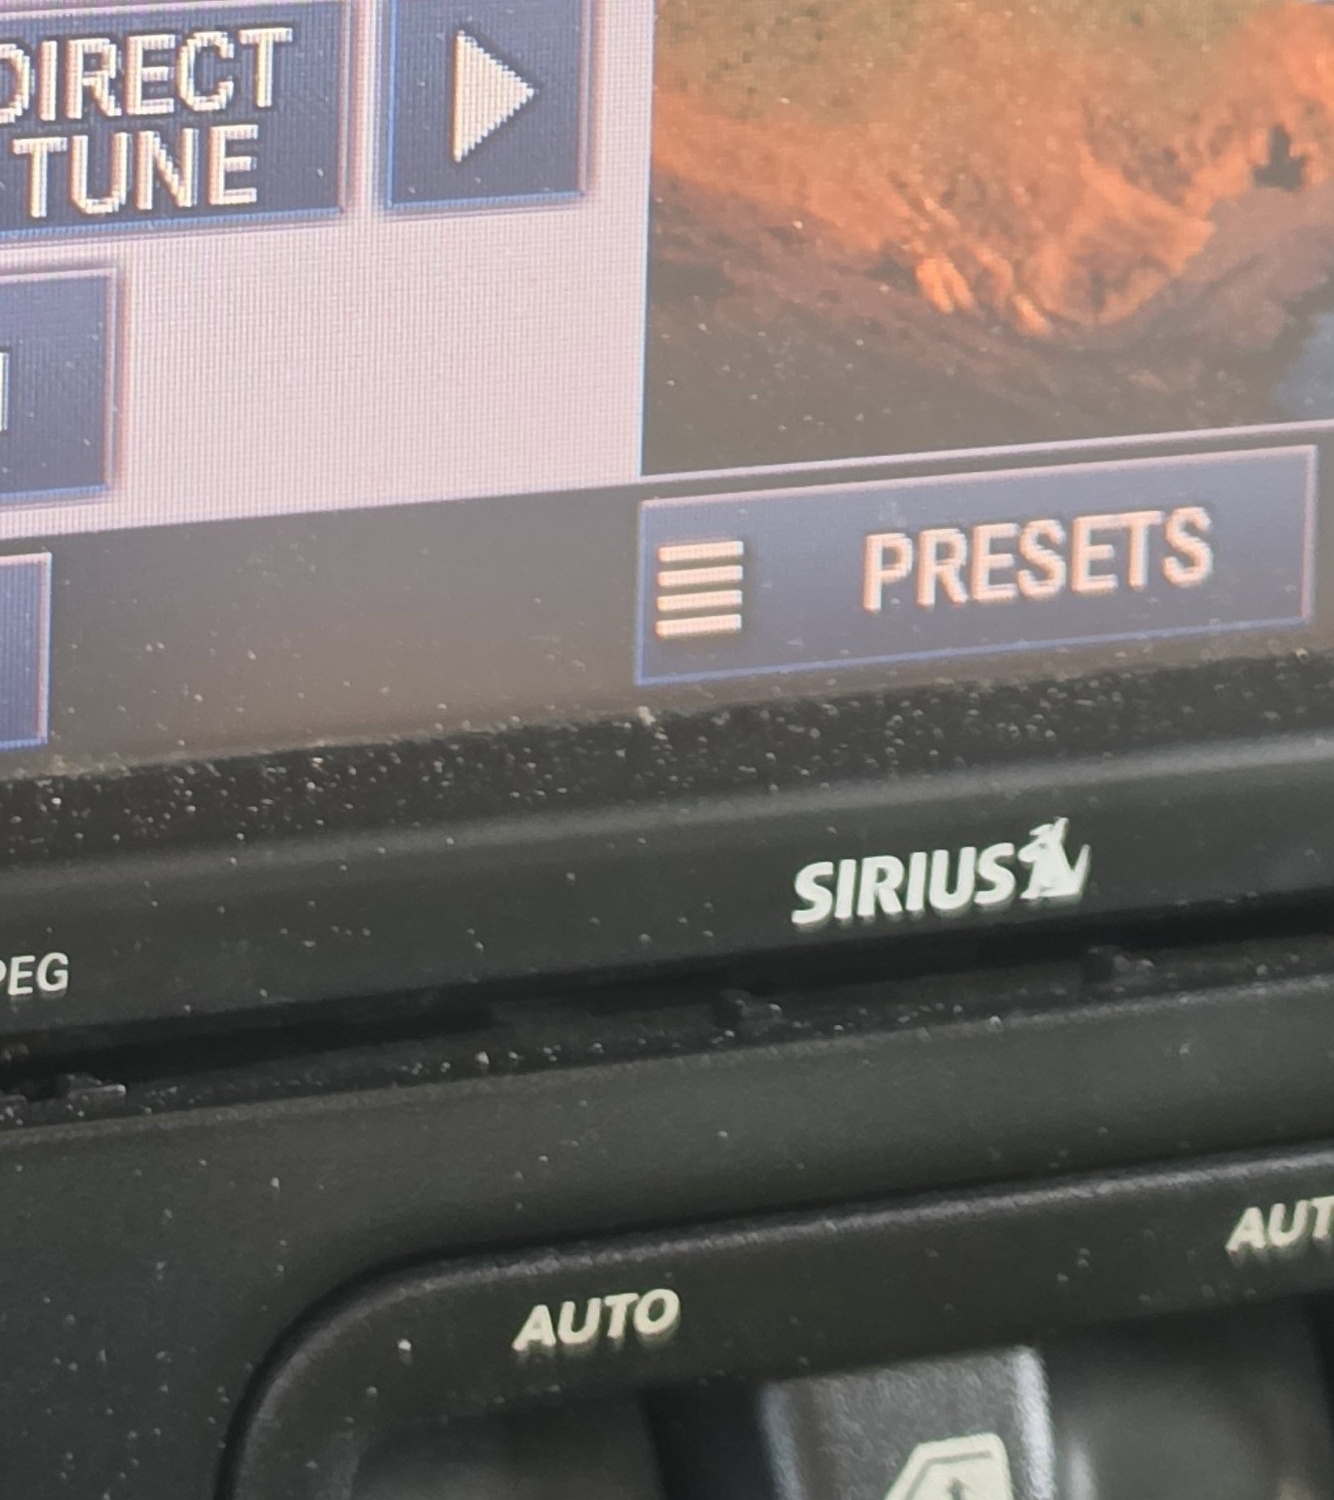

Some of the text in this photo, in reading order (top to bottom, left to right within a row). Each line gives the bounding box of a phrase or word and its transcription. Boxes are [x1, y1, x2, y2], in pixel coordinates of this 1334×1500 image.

[11, 124, 261, 219] TUNE
[861, 504, 1215, 615] PRESETS
[790, 842, 1017, 930] SIRIUS
[512, 1288, 681, 1354] AUTO
